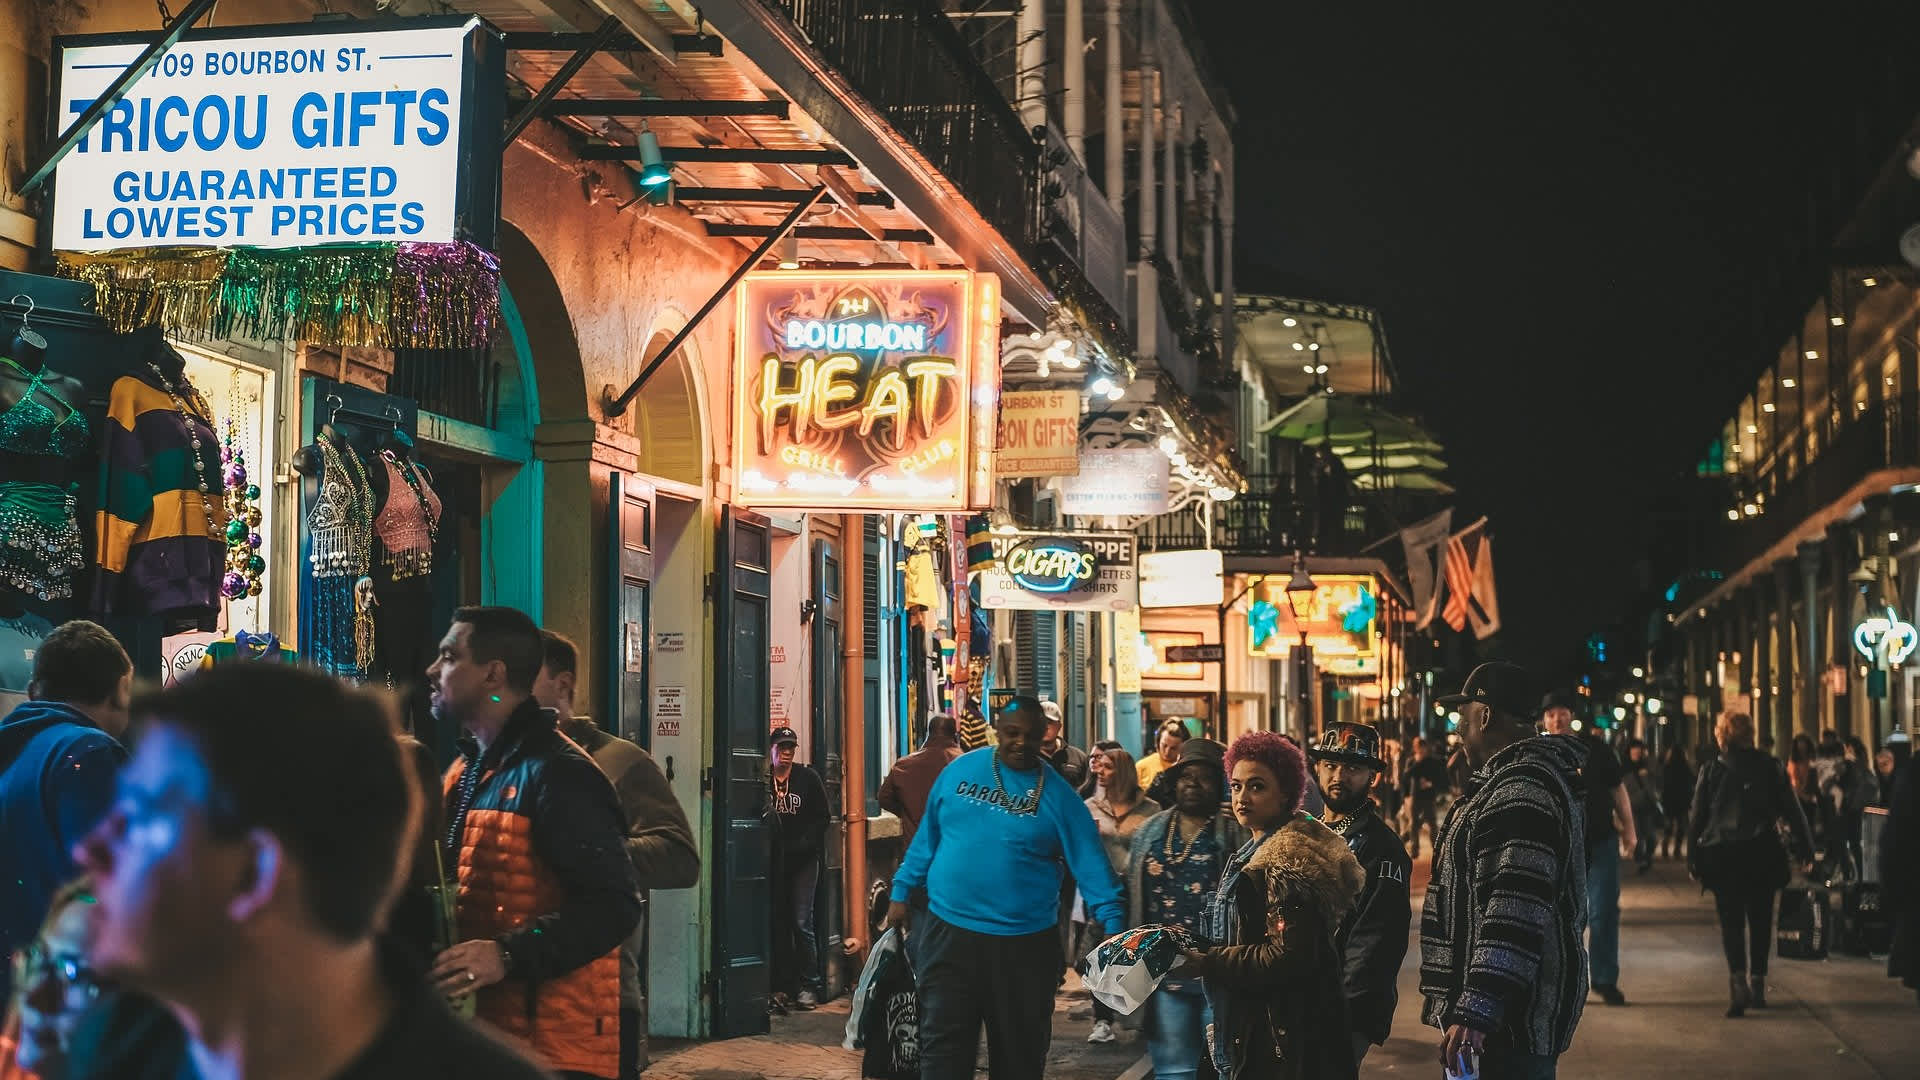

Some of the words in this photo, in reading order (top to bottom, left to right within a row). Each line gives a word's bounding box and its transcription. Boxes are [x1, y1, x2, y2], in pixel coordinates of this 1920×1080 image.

[204, 49, 326, 76] BOURBON
[336, 47, 372, 72] ST.
[69, 94, 268, 153] TRICOU
[291, 87, 450, 150] GIFTS
[113, 166, 398, 203] GUARANTEED
[82, 205, 253, 239] LOWEST
[271, 201, 425, 236] PRICES
[786, 320, 927, 351] BOURBON
[759, 354, 957, 456] HEAT
[1050, 395, 1064, 408] ST
[1033, 416, 1077, 447] GIFTS
[781, 446, 845, 477] GRILL
[899, 439, 955, 474] CLUB
[1008, 549, 1096, 580] CIGARS
[657, 721, 681, 730] ATM
[769, 792, 802, 816] AP
